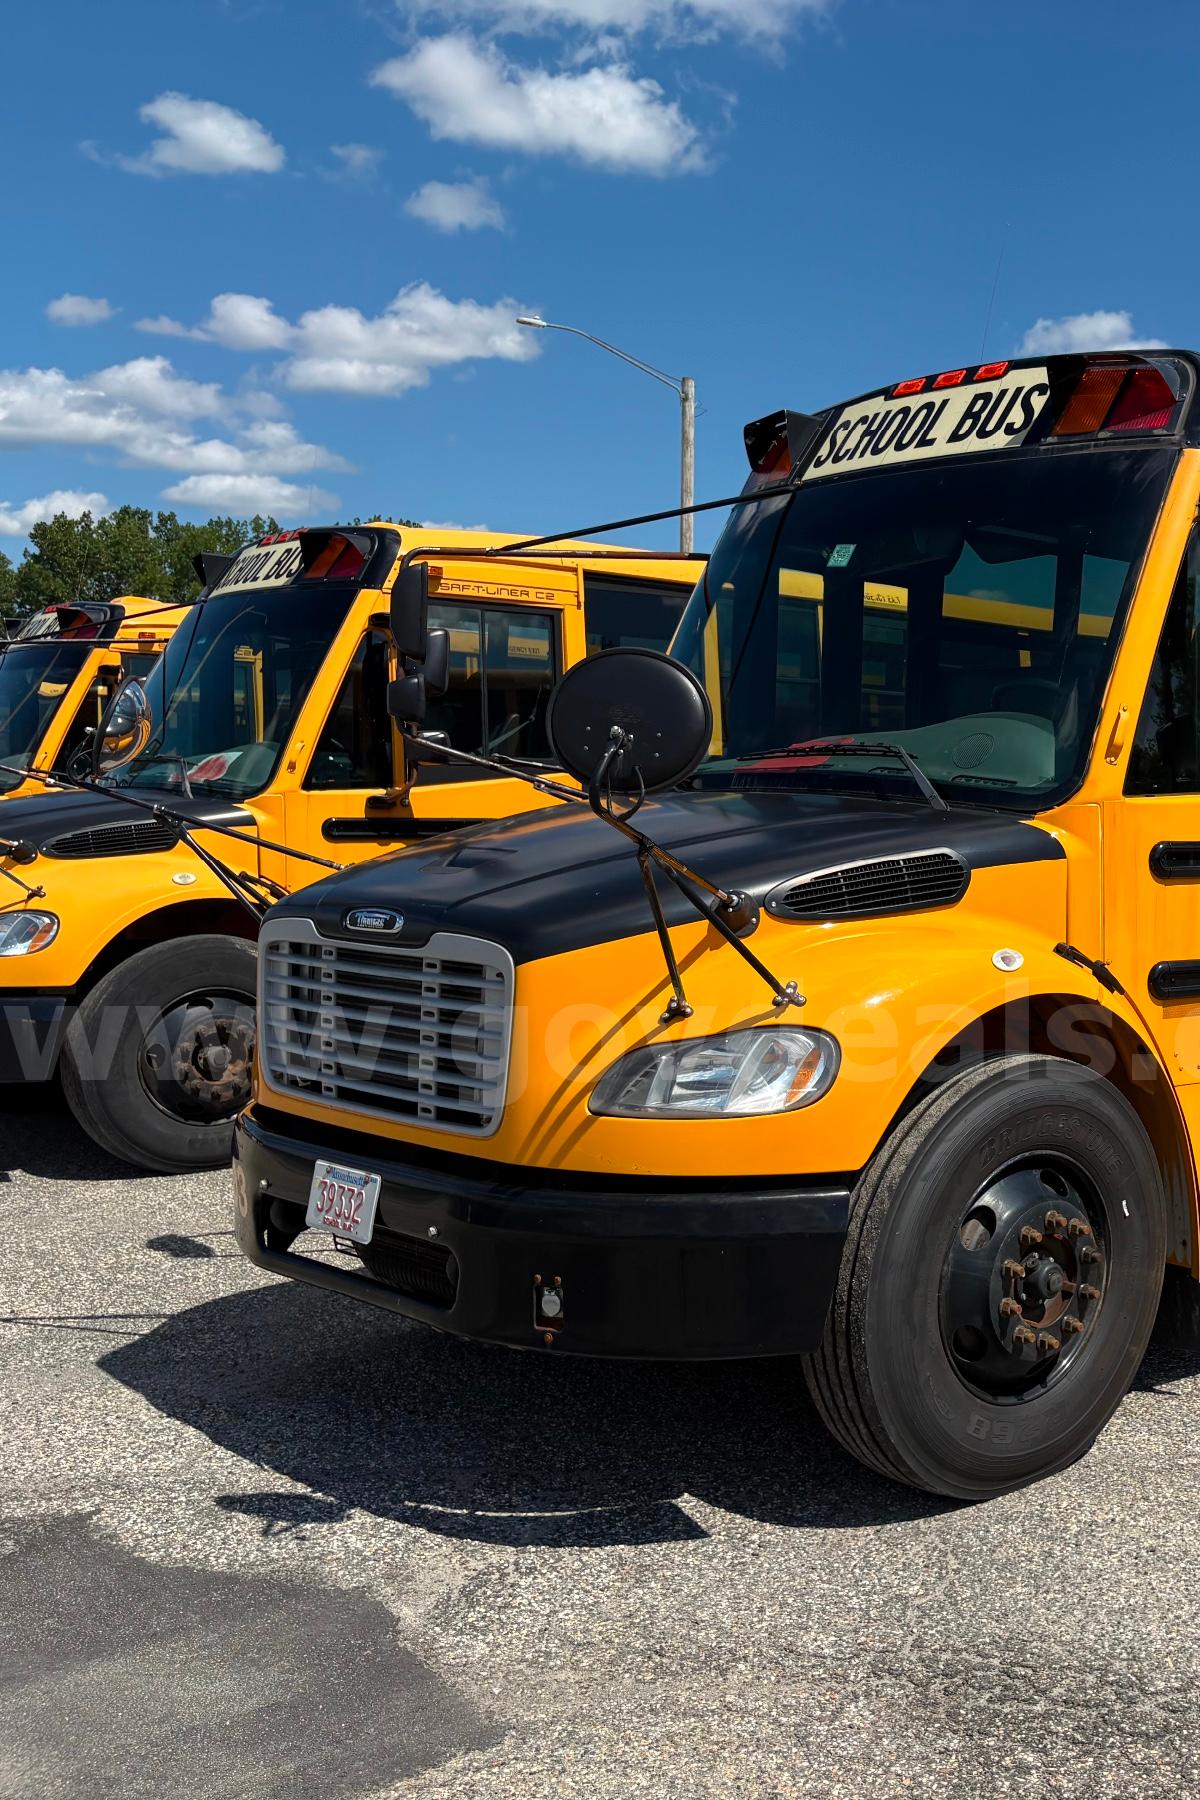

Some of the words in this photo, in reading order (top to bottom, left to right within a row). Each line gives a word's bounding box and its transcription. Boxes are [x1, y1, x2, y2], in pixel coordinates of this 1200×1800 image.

[812, 398, 951, 468] SCHOOL
[946, 382, 1050, 444] BUS
[536, 591, 555, 600] C2
[316, 1179, 366, 1225] 39332
